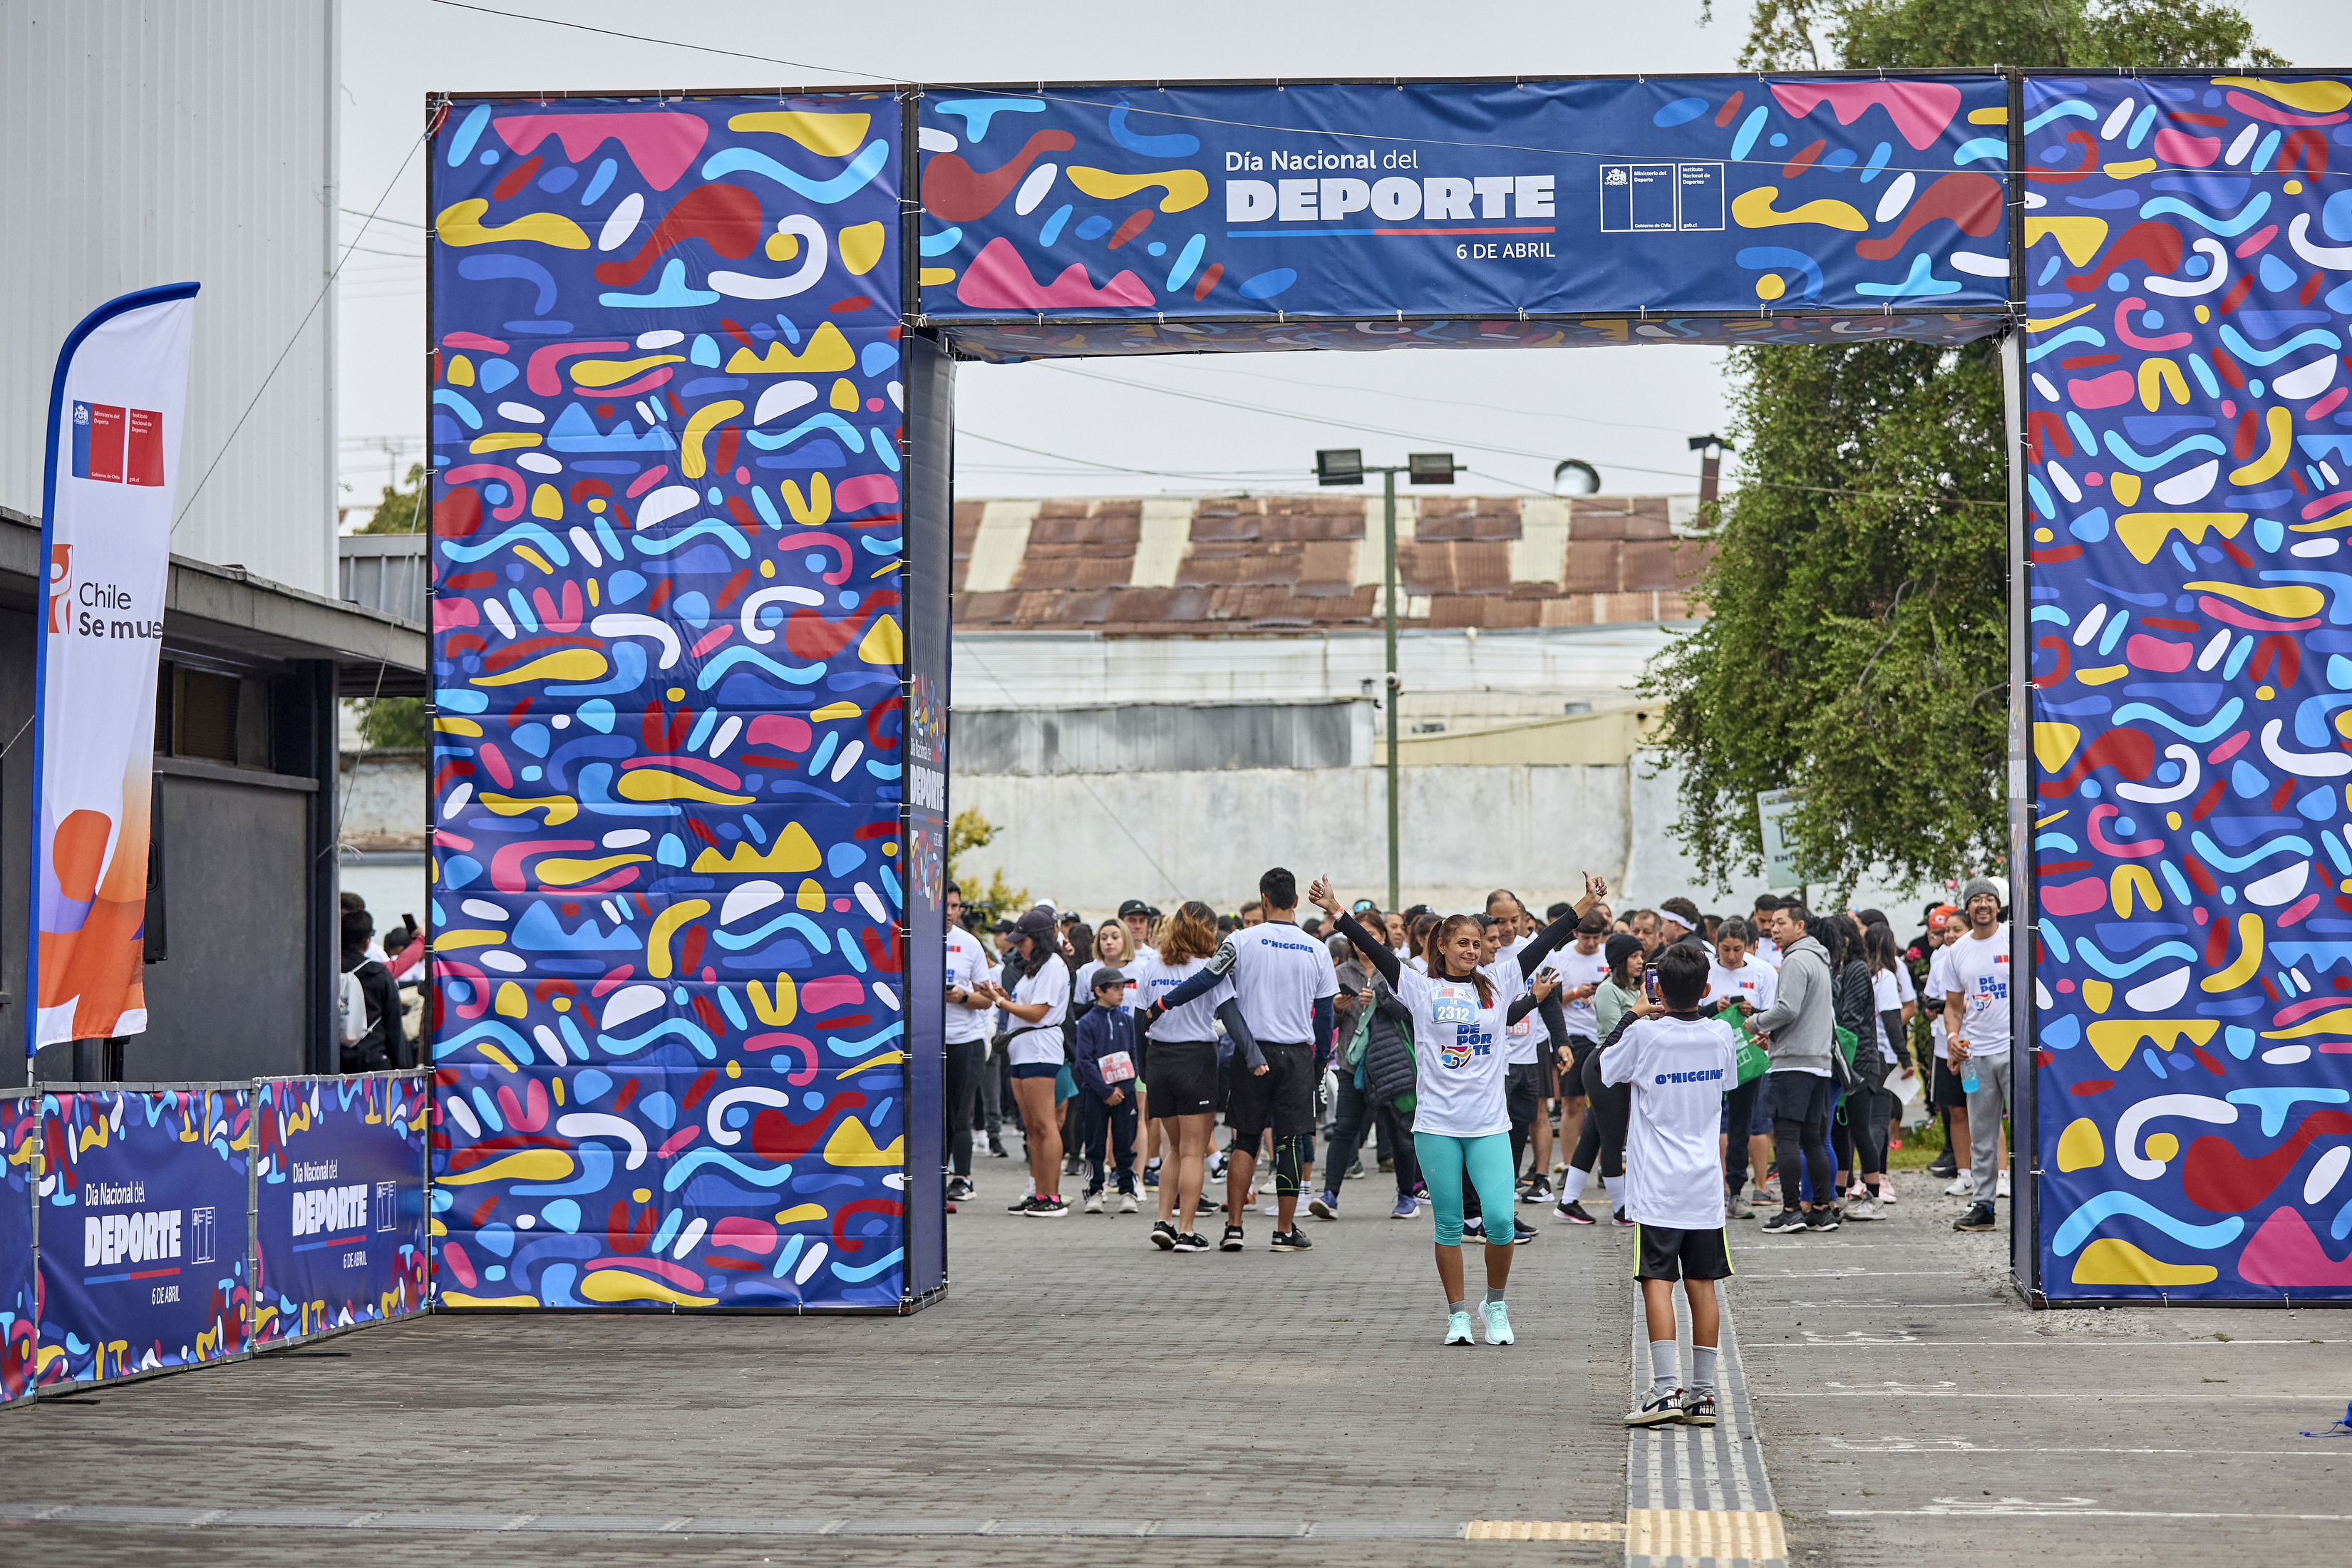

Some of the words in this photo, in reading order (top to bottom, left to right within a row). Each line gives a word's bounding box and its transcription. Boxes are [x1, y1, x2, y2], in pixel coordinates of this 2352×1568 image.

[1225, 150, 1267, 171] Día
[1270, 149, 1376, 170] Nacional
[1383, 150, 1418, 170] del
[1226, 175, 1555, 222] DEPORTE
[1455, 244, 1468, 259] 6
[1472, 244, 1498, 259] DE
[1502, 242, 1555, 258] ABRIL
[94, 411, 113, 419] Ministerio
[79, 582, 132, 610] Chile
[78, 612, 105, 638] Se
[910, 763, 944, 812] DEPORTE
[1261, 939, 1314, 953] O'HIGGINS
[1979, 976, 1994, 985] DE
[1980, 983, 2006, 993] POR
[1993, 991, 2008, 999] TE
[1438, 1006, 1470, 1021] 2312
[1457, 1023, 1480, 1035] DE
[1457, 1033, 1492, 1046] POR
[1473, 1044, 1491, 1056] TE
[293, 1162, 304, 1184] Día
[304, 1160, 329, 1182] Nacional
[329, 1159, 338, 1179] del
[86, 1183, 99, 1207] Día
[100, 1181, 133, 1206] Nacional
[134, 1180, 145, 1204] del
[292, 1184, 368, 1237] DEPORTE
[84, 1209, 182, 1267] DEPORTE
[343, 1253, 347, 1269] 6
[347, 1252, 354, 1269] DE
[354, 1251, 368, 1267] ABRIL
[152, 1287, 156, 1305] 6
[156, 1286, 165, 1304] DE
[165, 1285, 180, 1304] ABRIL
